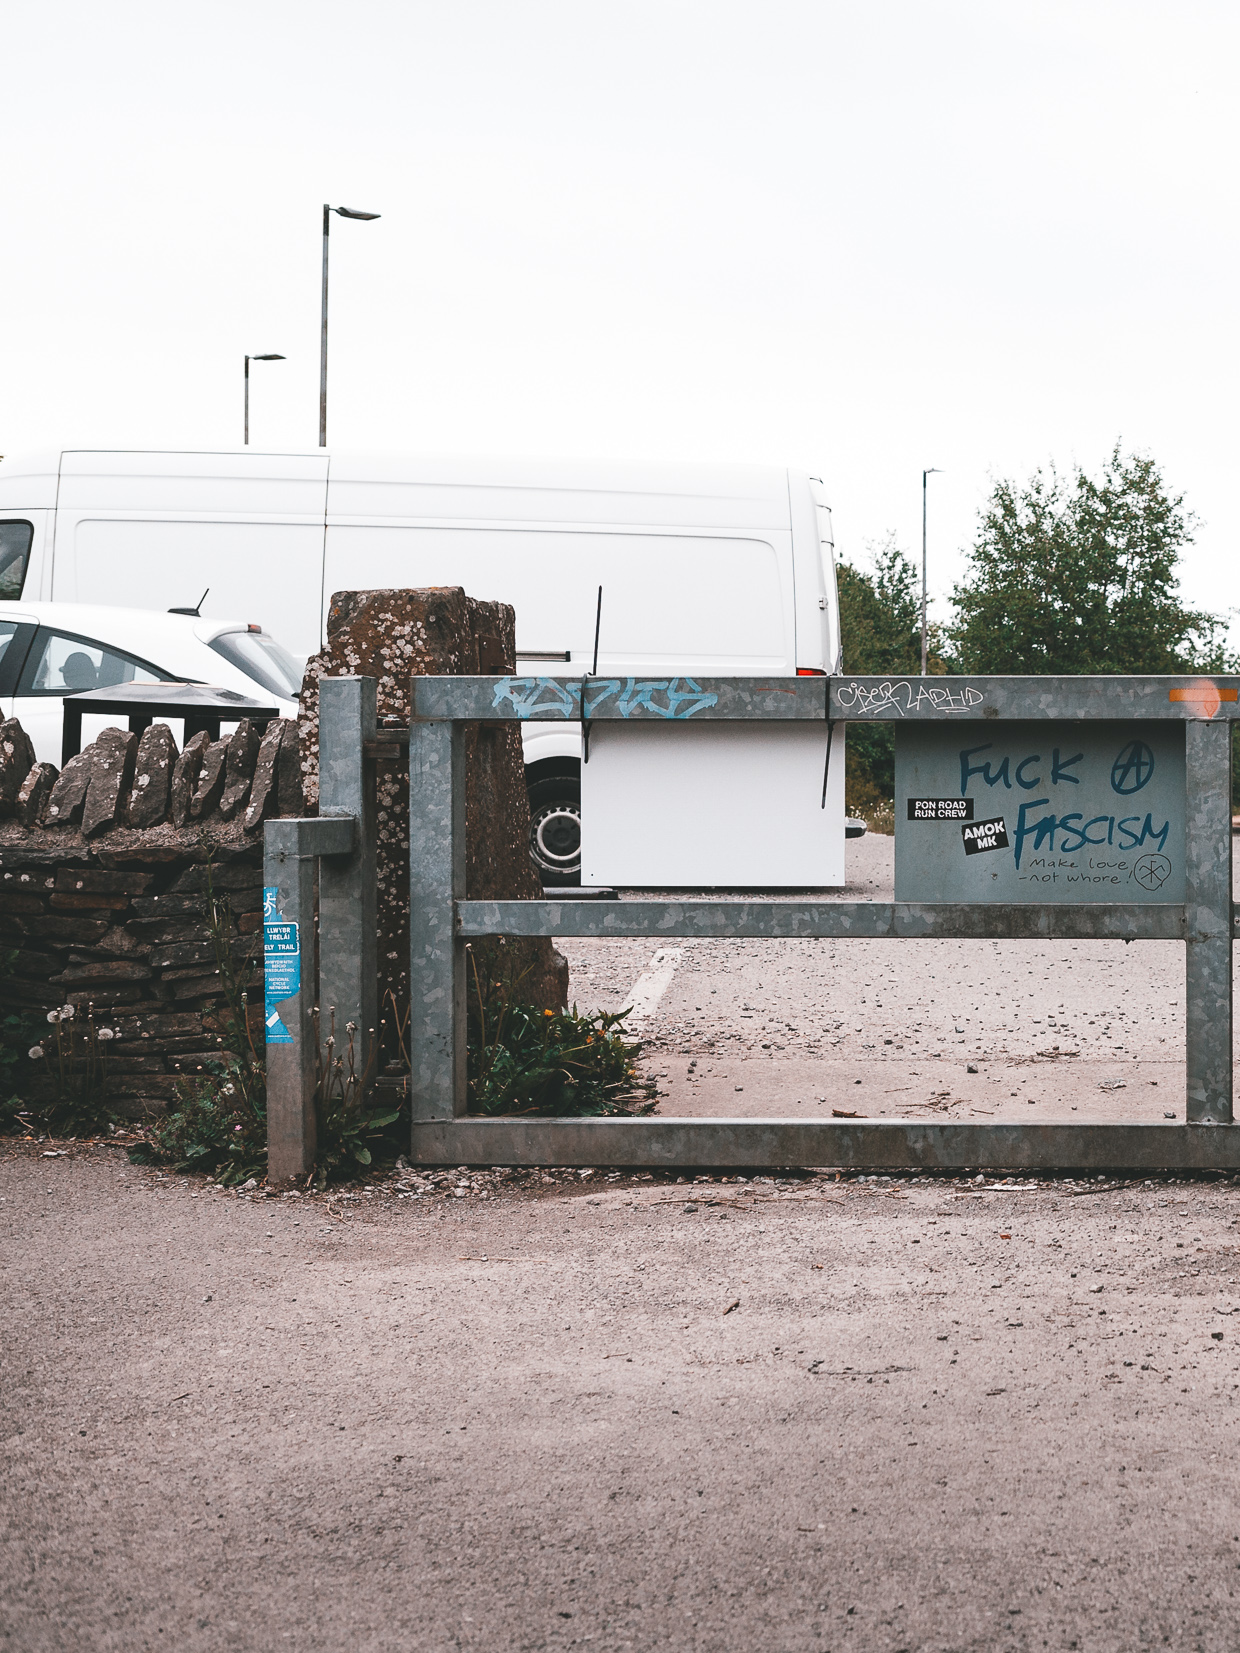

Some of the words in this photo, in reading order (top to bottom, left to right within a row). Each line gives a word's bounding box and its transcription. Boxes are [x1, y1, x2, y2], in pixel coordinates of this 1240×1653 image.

[959, 743, 1084, 796] FUCK
[915, 801, 936, 809] PON
[938, 801, 966, 809] ROAD
[914, 810, 936, 818] RUN
[937, 810, 966, 818] CREW
[964, 820, 1005, 840] AMOK
[976, 836, 997, 849] MK
